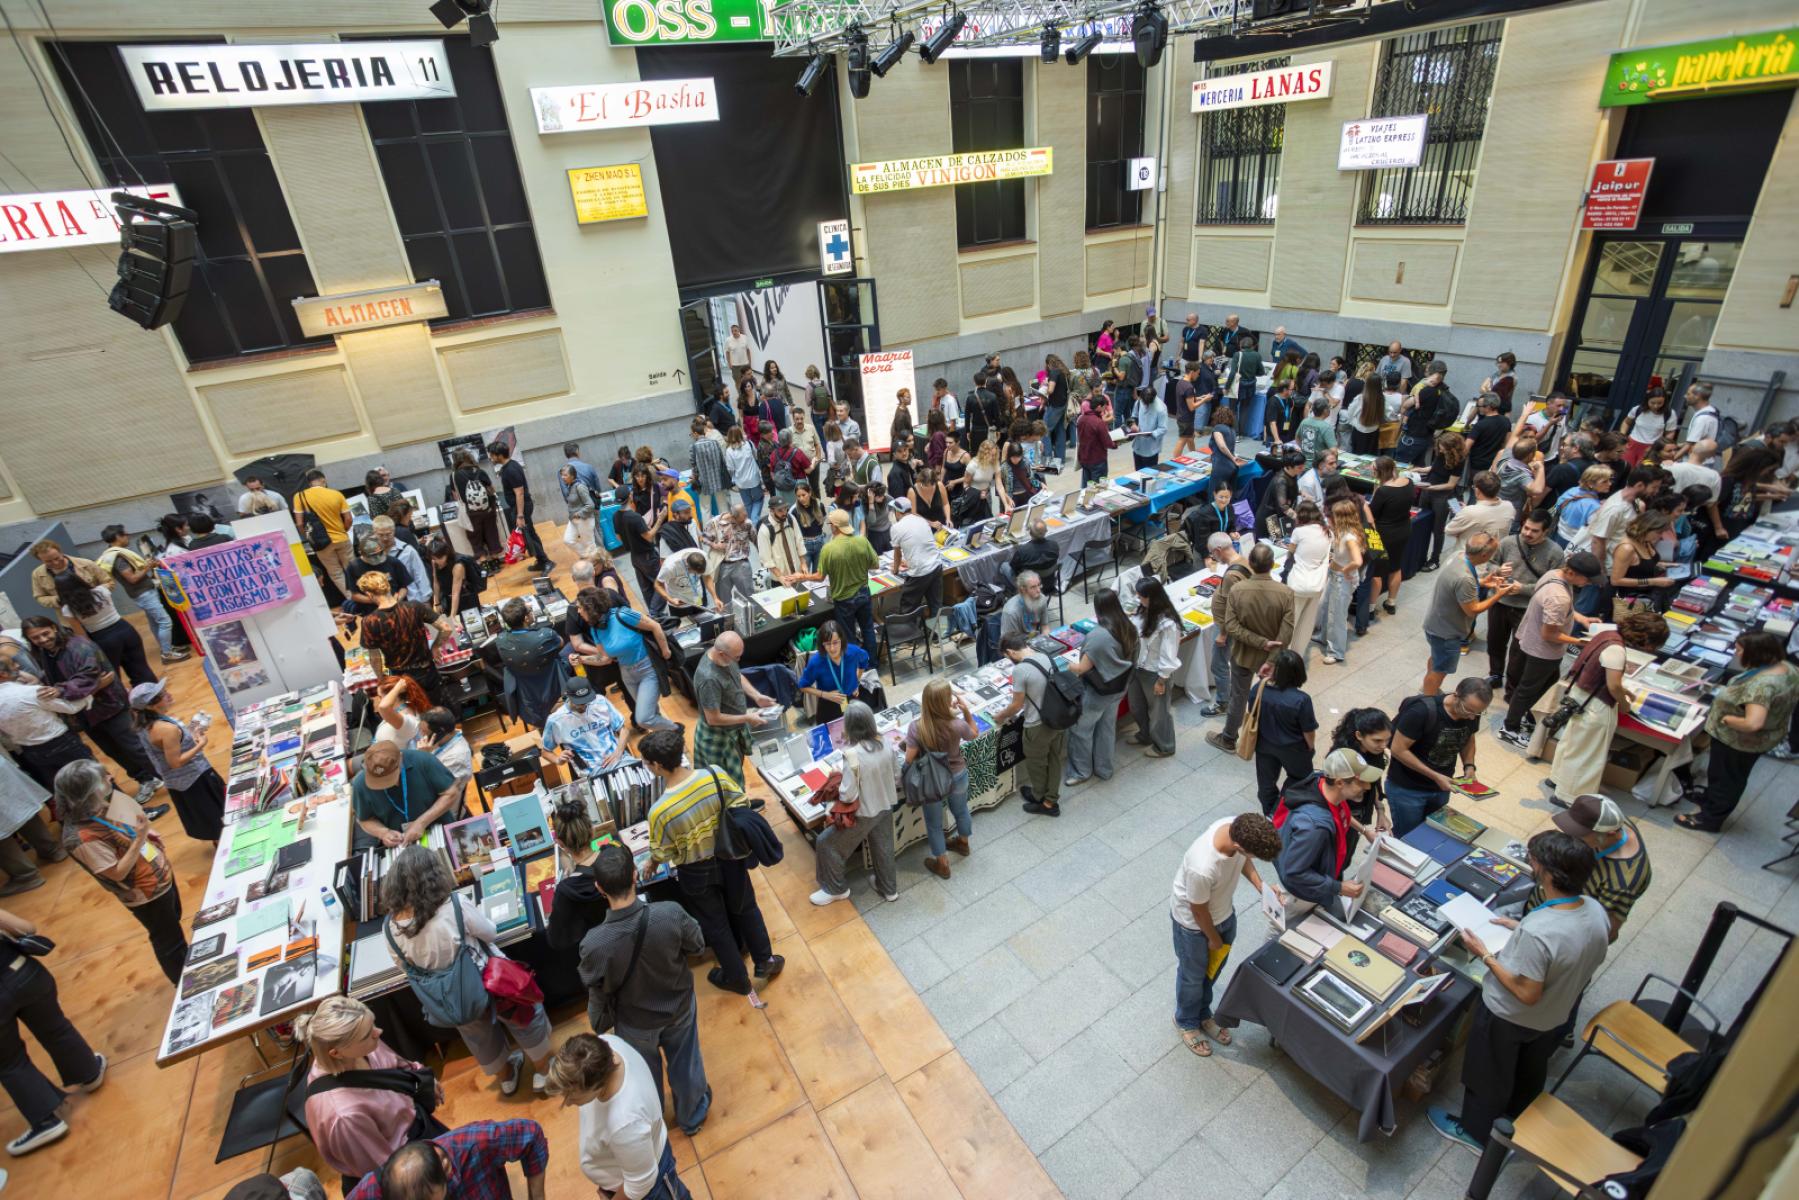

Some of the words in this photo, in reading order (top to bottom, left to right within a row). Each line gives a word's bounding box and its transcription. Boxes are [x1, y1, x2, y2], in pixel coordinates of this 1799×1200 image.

[142, 56, 396, 95] RELOJERIA
[418, 57, 440, 82] 11
[1200, 87, 1243, 106] MERCERIA
[1251, 69, 1322, 100] LANAS
[570, 91, 609, 123] El
[624, 84, 706, 120] Basha
[1355, 135, 1382, 145] LATINO
[1383, 132, 1416, 143] EXPRESS
[1370, 123, 1397, 134] VIAJES
[883, 157, 943, 173] ALMACEN
[950, 153, 963, 167] DE
[967, 151, 1027, 164] CALZADOS
[856, 176, 867, 184] LA
[870, 172, 912, 182] FELICIDAD
[917, 163, 997, 186] VINIGON
[858, 184, 869, 192] DE
[873, 182, 889, 190] SUS
[893, 180, 910, 189] PIES
[1592, 180, 1641, 194] jaipur
[0, 199, 87, 243] RIA
[824, 223, 847, 234] CLINICA
[324, 297, 414, 327] ALMACEN
[862, 350, 912, 364] Madrid
[862, 361, 893, 374] será
[191, 558, 268, 590] BISEXUALES
[187, 589, 206, 606] EN
[207, 576, 259, 601] CONTRA
[259, 569, 283, 587] DEL
[212, 587, 272, 614] FASCISMO
